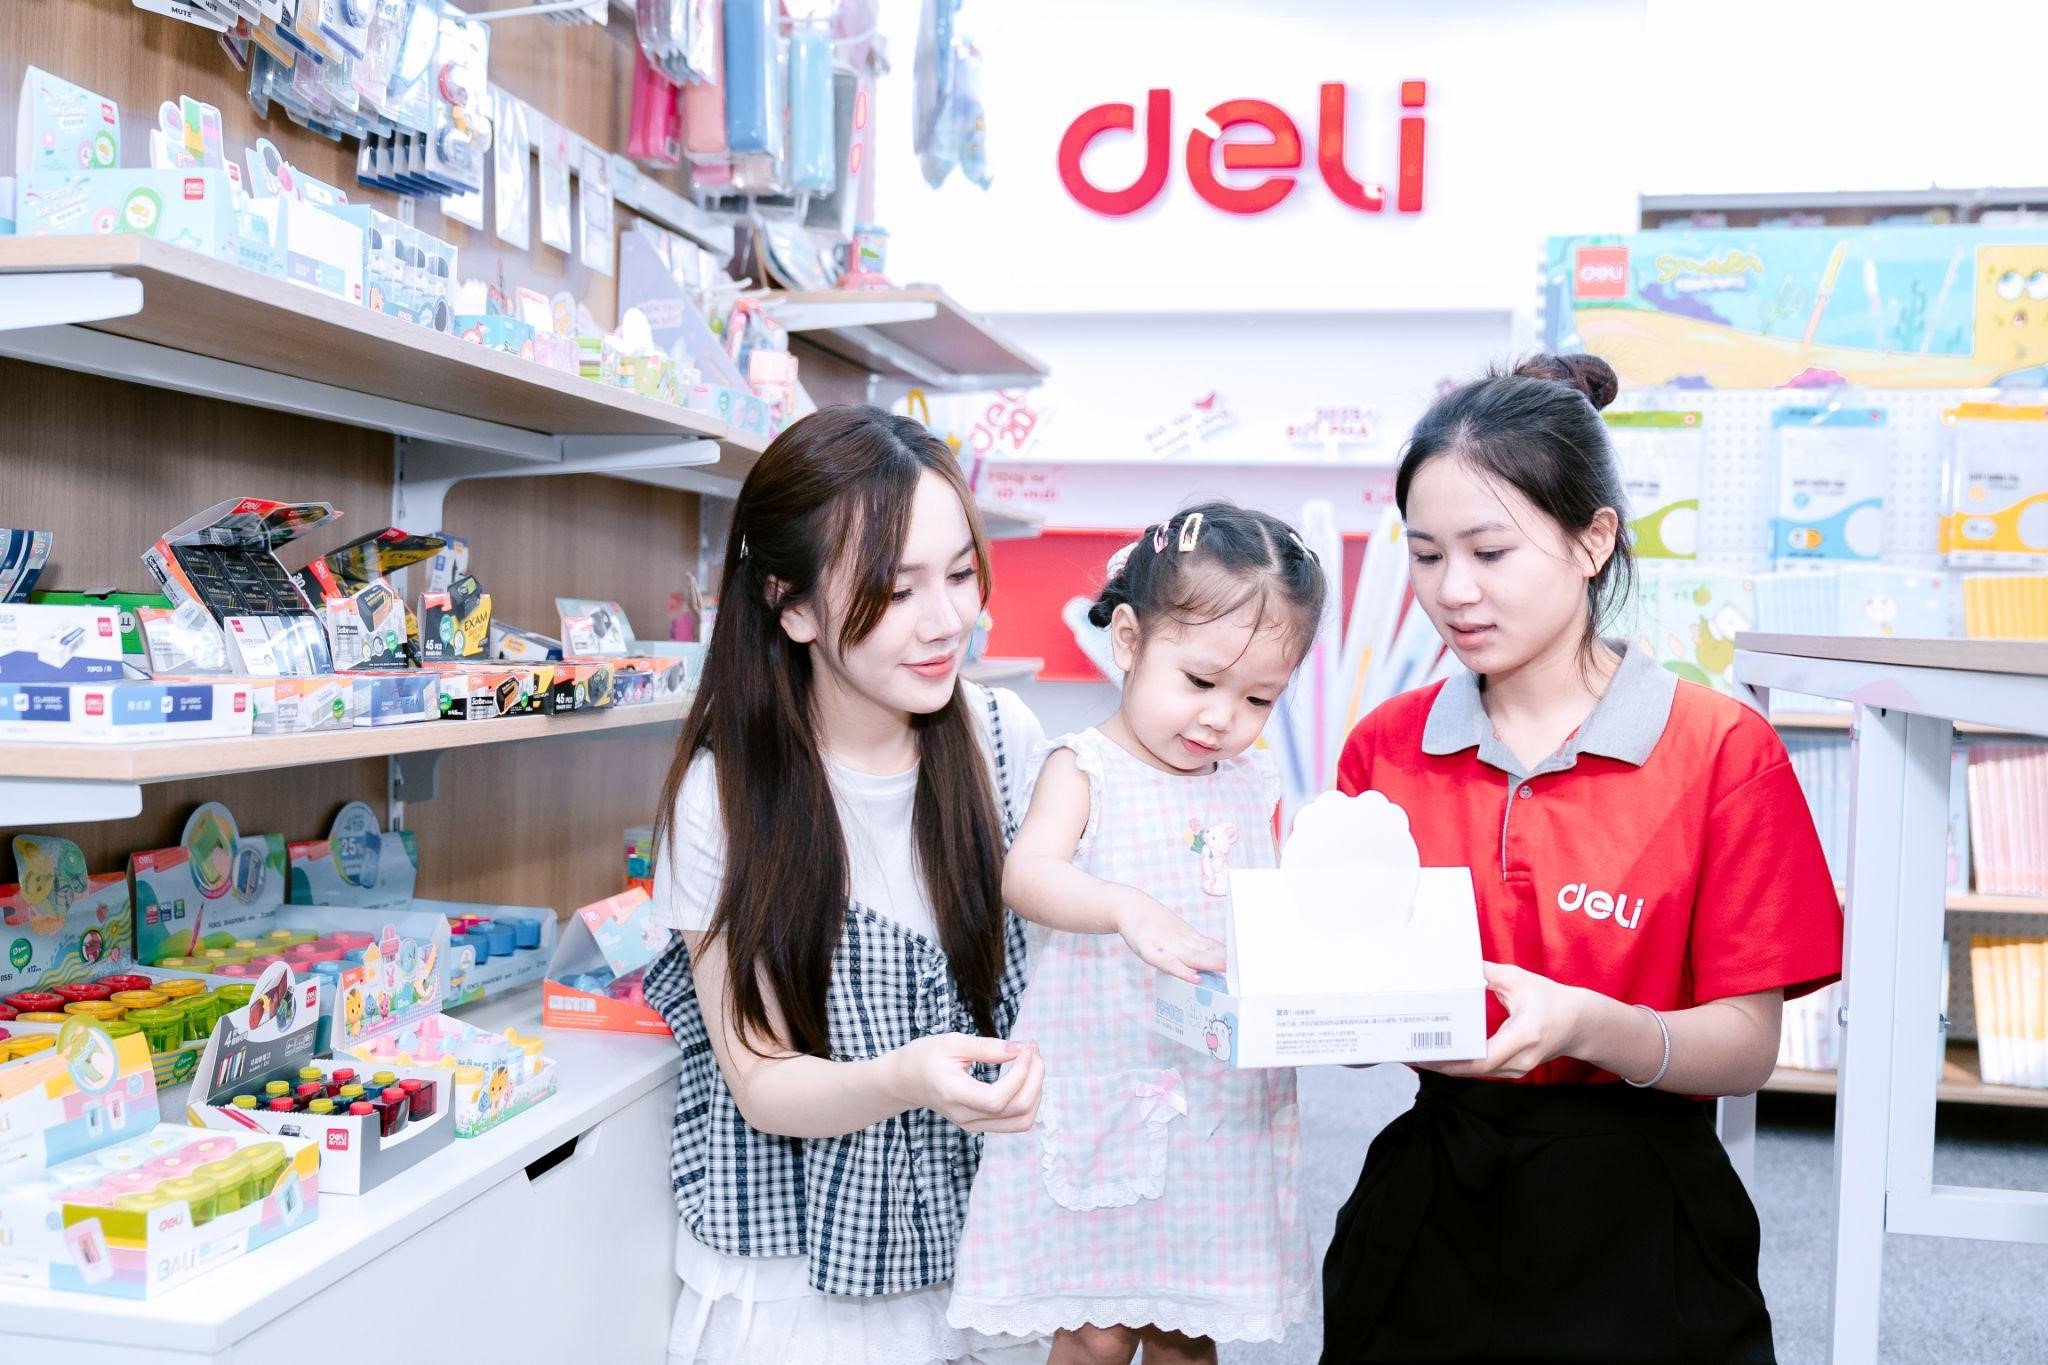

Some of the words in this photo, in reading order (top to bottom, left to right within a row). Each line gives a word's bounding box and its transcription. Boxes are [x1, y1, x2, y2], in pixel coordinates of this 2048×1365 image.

[171, 7, 193, 18] MUTE
[1058, 80, 1427, 216] deli
[314, 560, 329, 580] deli
[464, 611, 488, 632] EXAM
[425, 639, 435, 650] 45
[341, 838, 357, 856] 25
[1556, 882, 1646, 931] deli
[328, 1132, 347, 1141] deli
[158, 1212, 184, 1232] deli
